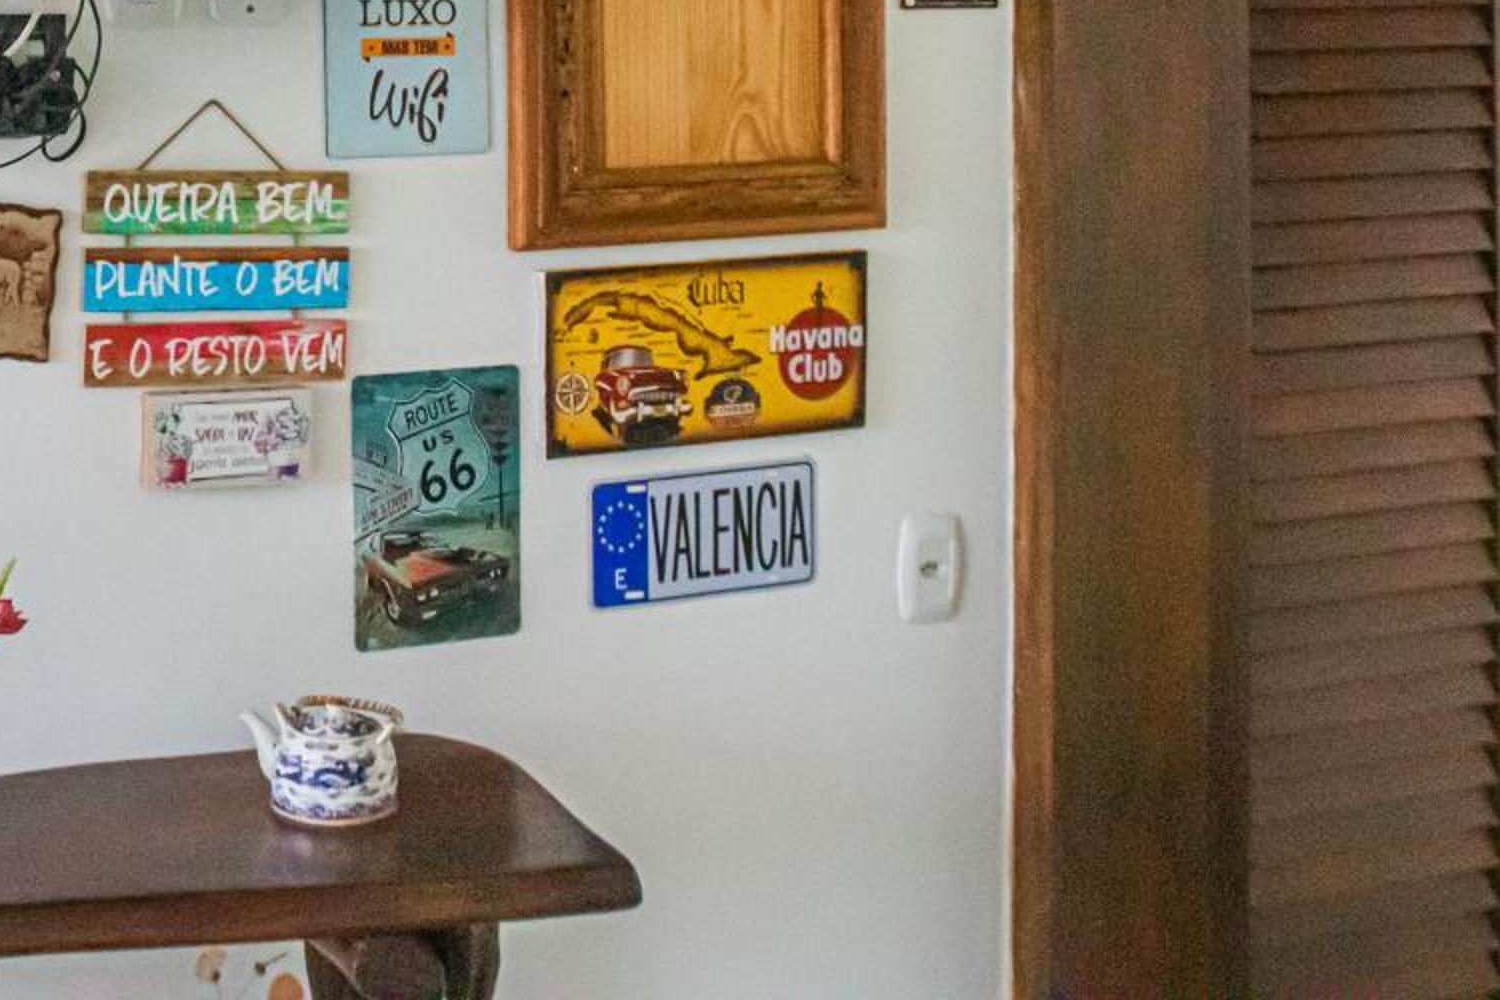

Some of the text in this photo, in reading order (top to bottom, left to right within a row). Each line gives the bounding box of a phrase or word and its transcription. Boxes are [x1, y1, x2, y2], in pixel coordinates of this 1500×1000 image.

[369, 68, 449, 143] Wifi
[104, 180, 336, 224] QUEIRA BEM
[94, 255, 340, 299] PLANTE O BEM
[687, 271, 745, 307] Cuba
[89, 330, 344, 380] E O RESTO VEM
[770, 323, 864, 354] Havana
[787, 352, 843, 384] Club
[403, 392, 460, 431] ROUTE
[422, 428, 454, 452] US
[420, 448, 477, 504] 66
[615, 479, 809, 591] E VALENCIA
